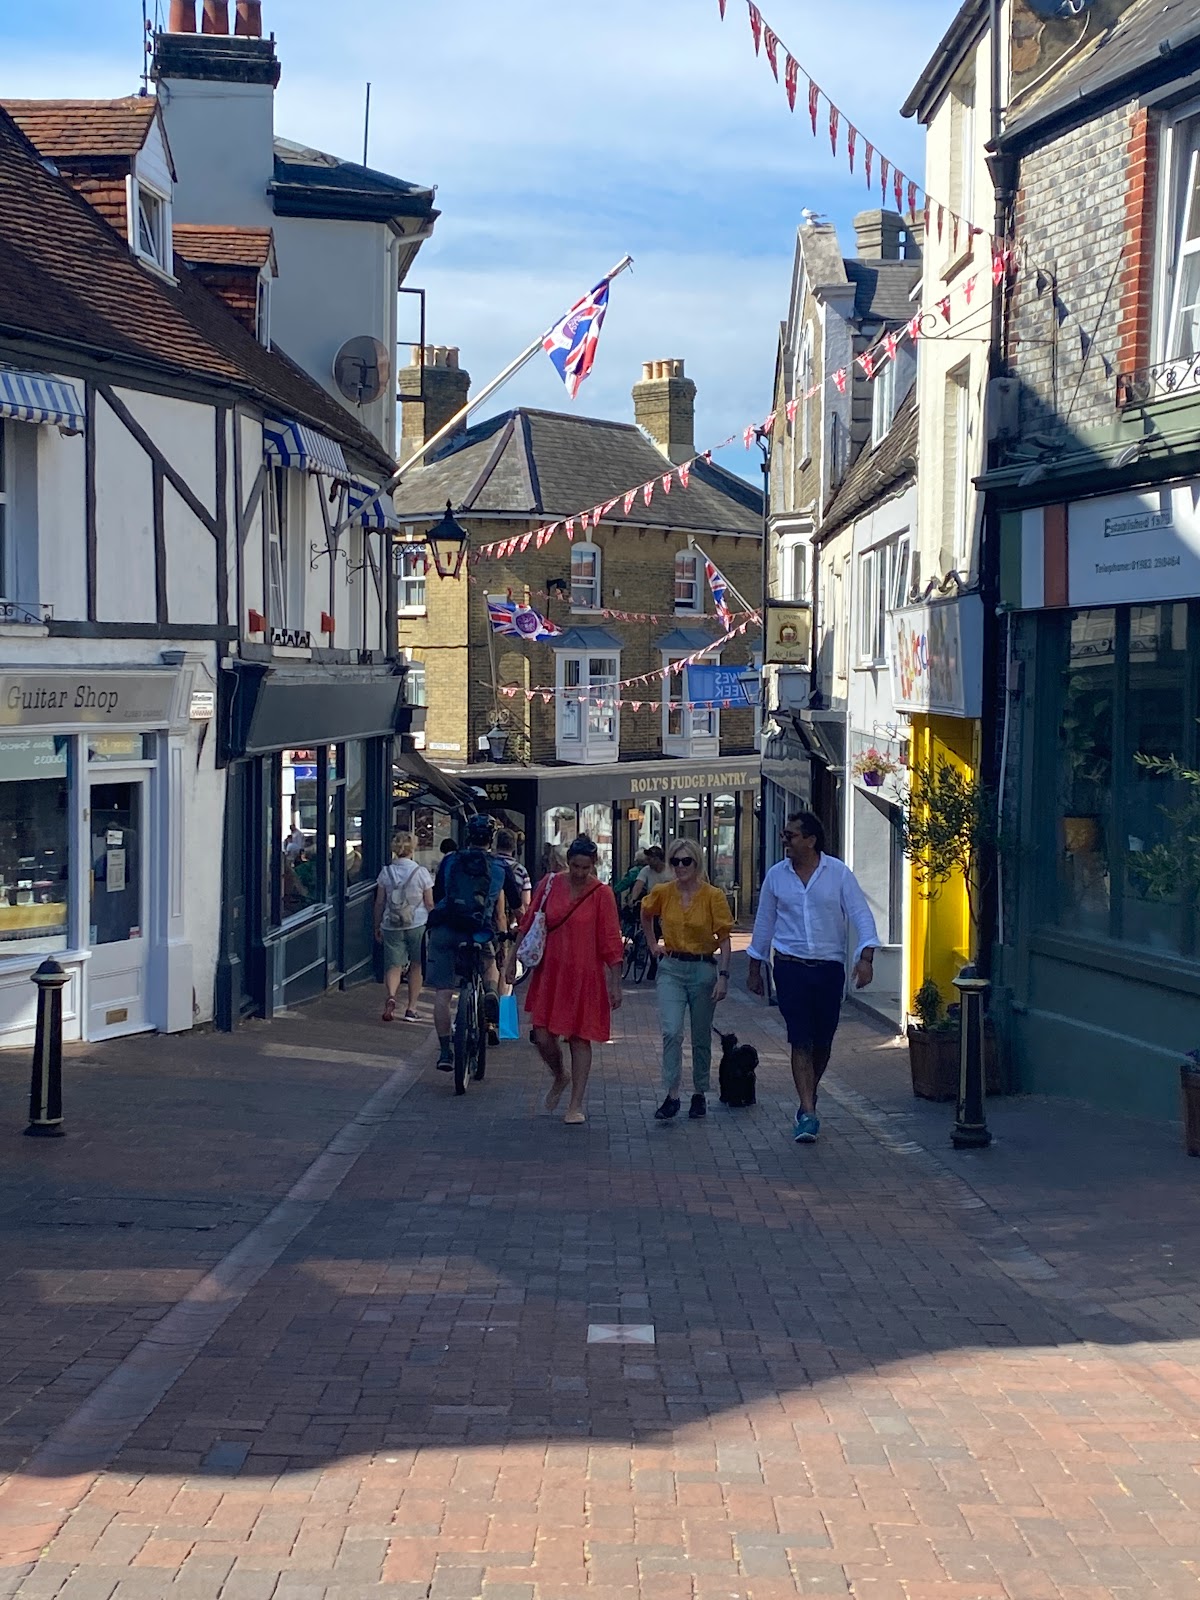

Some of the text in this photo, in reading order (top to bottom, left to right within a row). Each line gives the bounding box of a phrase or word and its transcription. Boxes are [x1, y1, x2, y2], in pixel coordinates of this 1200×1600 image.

[7, 685, 119, 713] Guitar Shop
[485, 784, 508, 792] EST
[630, 777, 669, 793] ROLY'S
[671, 774, 705, 790] FUDGE
[707, 771, 748, 787] PANTRY
